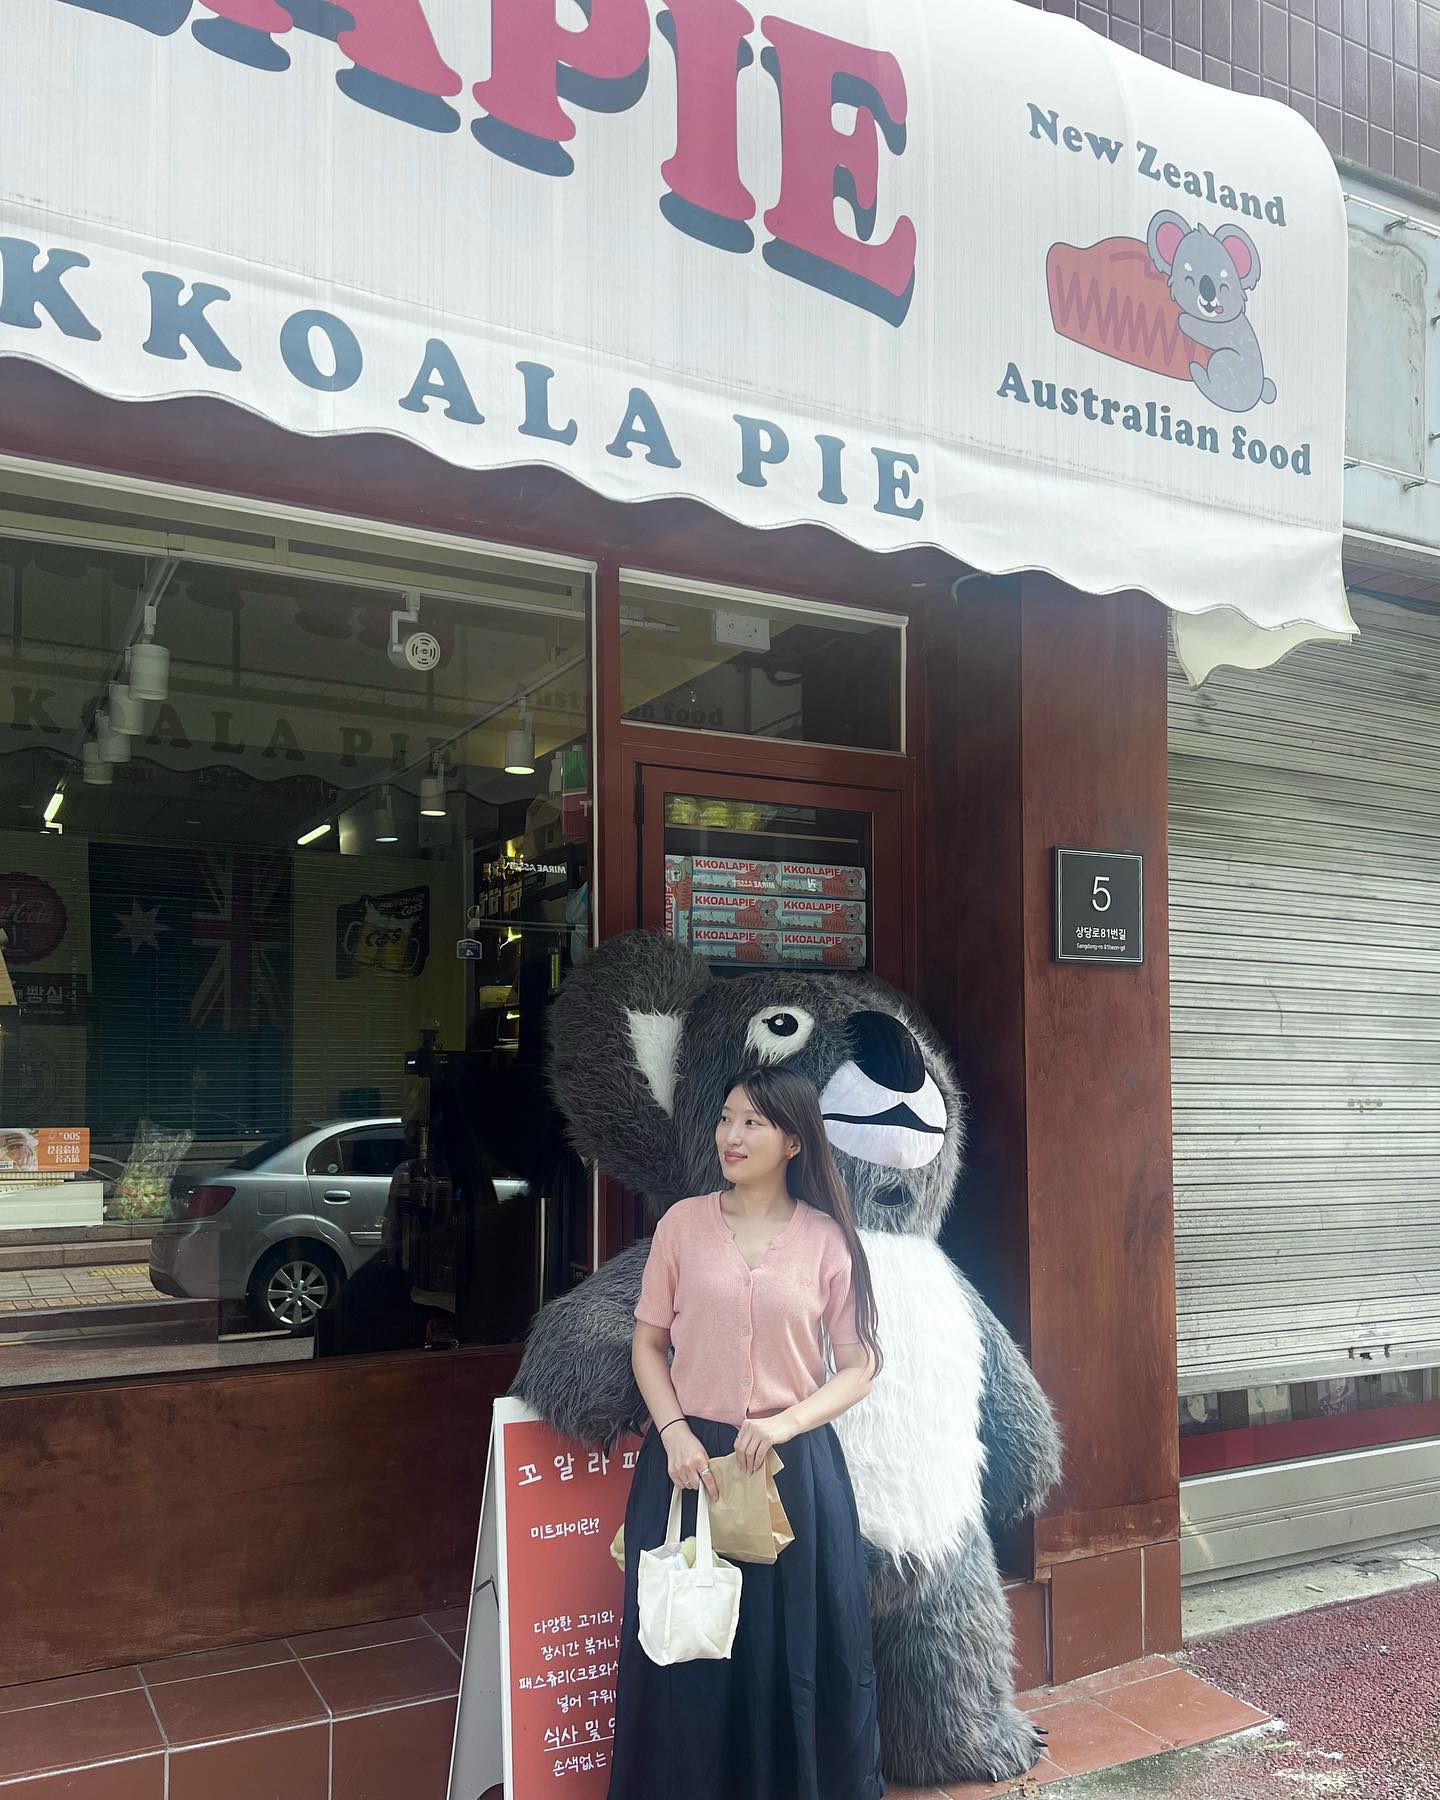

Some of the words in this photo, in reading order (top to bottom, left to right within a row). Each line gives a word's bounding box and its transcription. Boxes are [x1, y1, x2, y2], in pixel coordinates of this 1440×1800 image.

[1026, 103, 1124, 165] New
[1136, 140, 1287, 227] Zealand
[0, 237, 682, 469] KKOALA
[732, 415, 924, 522] PIE
[996, 362, 1220, 454] Australian
[1231, 425, 1312, 476] food
[694, 859, 756, 872] KKOALAPIE
[783, 865, 841, 877] KKOALAPIE
[694, 895, 756, 908] KKOALAPIE
[1092, 876, 1111, 911] 5
[783, 901, 841, 912] KKOALAPIE
[694, 930, 756, 941] KKOALAPIE
[783, 934, 841, 945] KKOALAPIE
[1076, 926, 1126, 941] 상당로81번길
[530, 1517, 600, 1540] 미트파이란?
[533, 1615, 572, 1634] 다양한
[577, 1610, 615, 1628] 고기와
[541, 1640, 580, 1661] 장시간
[585, 1635, 620, 1656] 볶거나
[557, 1694, 582, 1713] 넣어
[588, 1689, 617, 1707] 구워
[544, 1724, 579, 1748] 식사
[585, 1719, 601, 1741] 및
[552, 1751, 607, 1778] 손색없는
